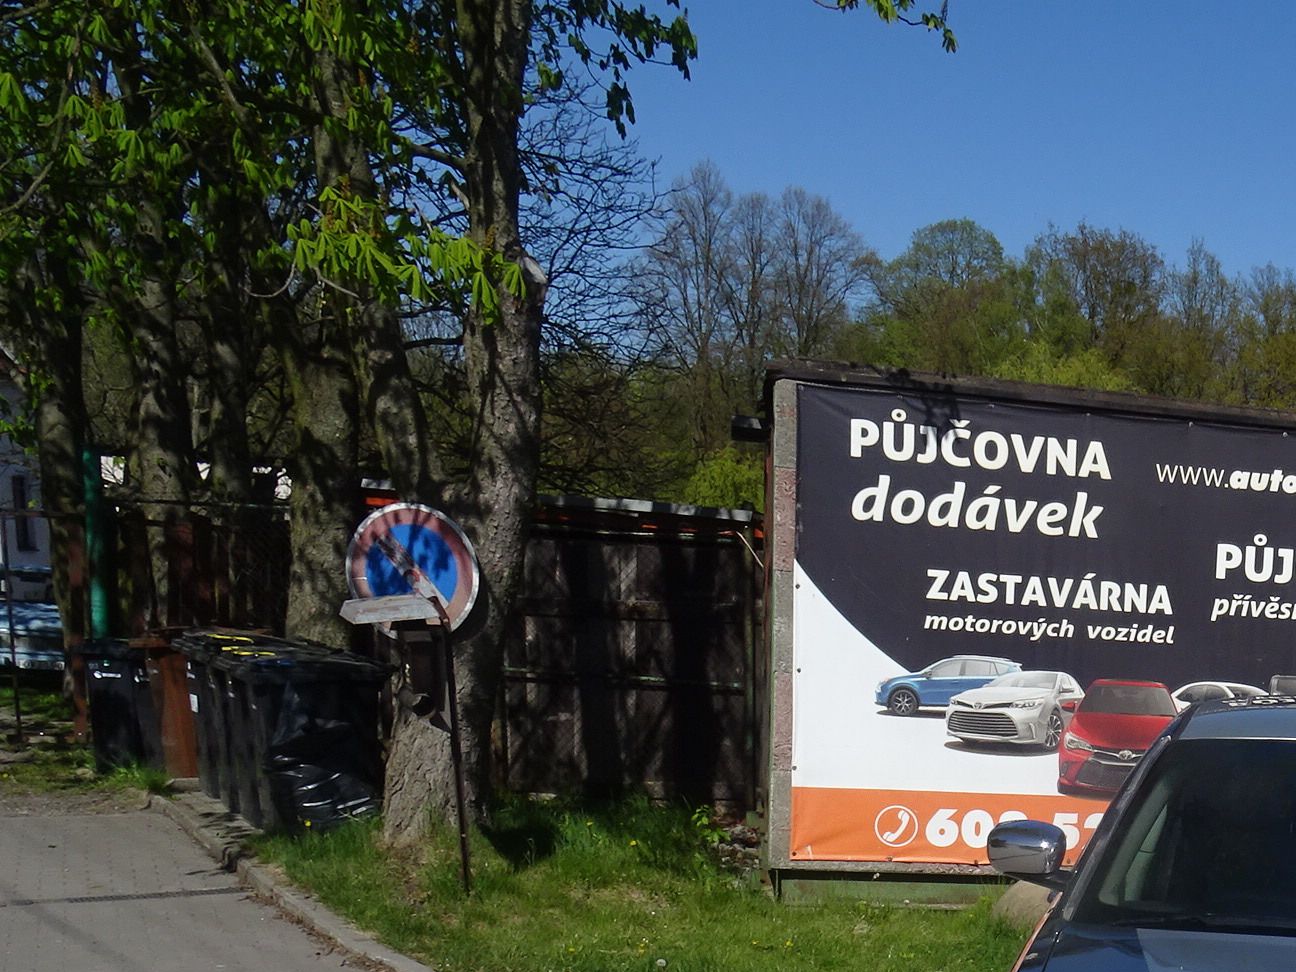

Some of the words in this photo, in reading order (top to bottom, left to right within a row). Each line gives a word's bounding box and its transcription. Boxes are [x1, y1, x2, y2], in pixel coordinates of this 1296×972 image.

[849, 408, 1112, 480] PŮJČOVNA
[850, 474, 1104, 539] dodávek
[925, 568, 1173, 615] ZASTAVÁRNA
[923, 613, 1075, 641] motorových
[1087, 622, 1176, 645] vozidel
[925, 808, 1028, 849] 60
